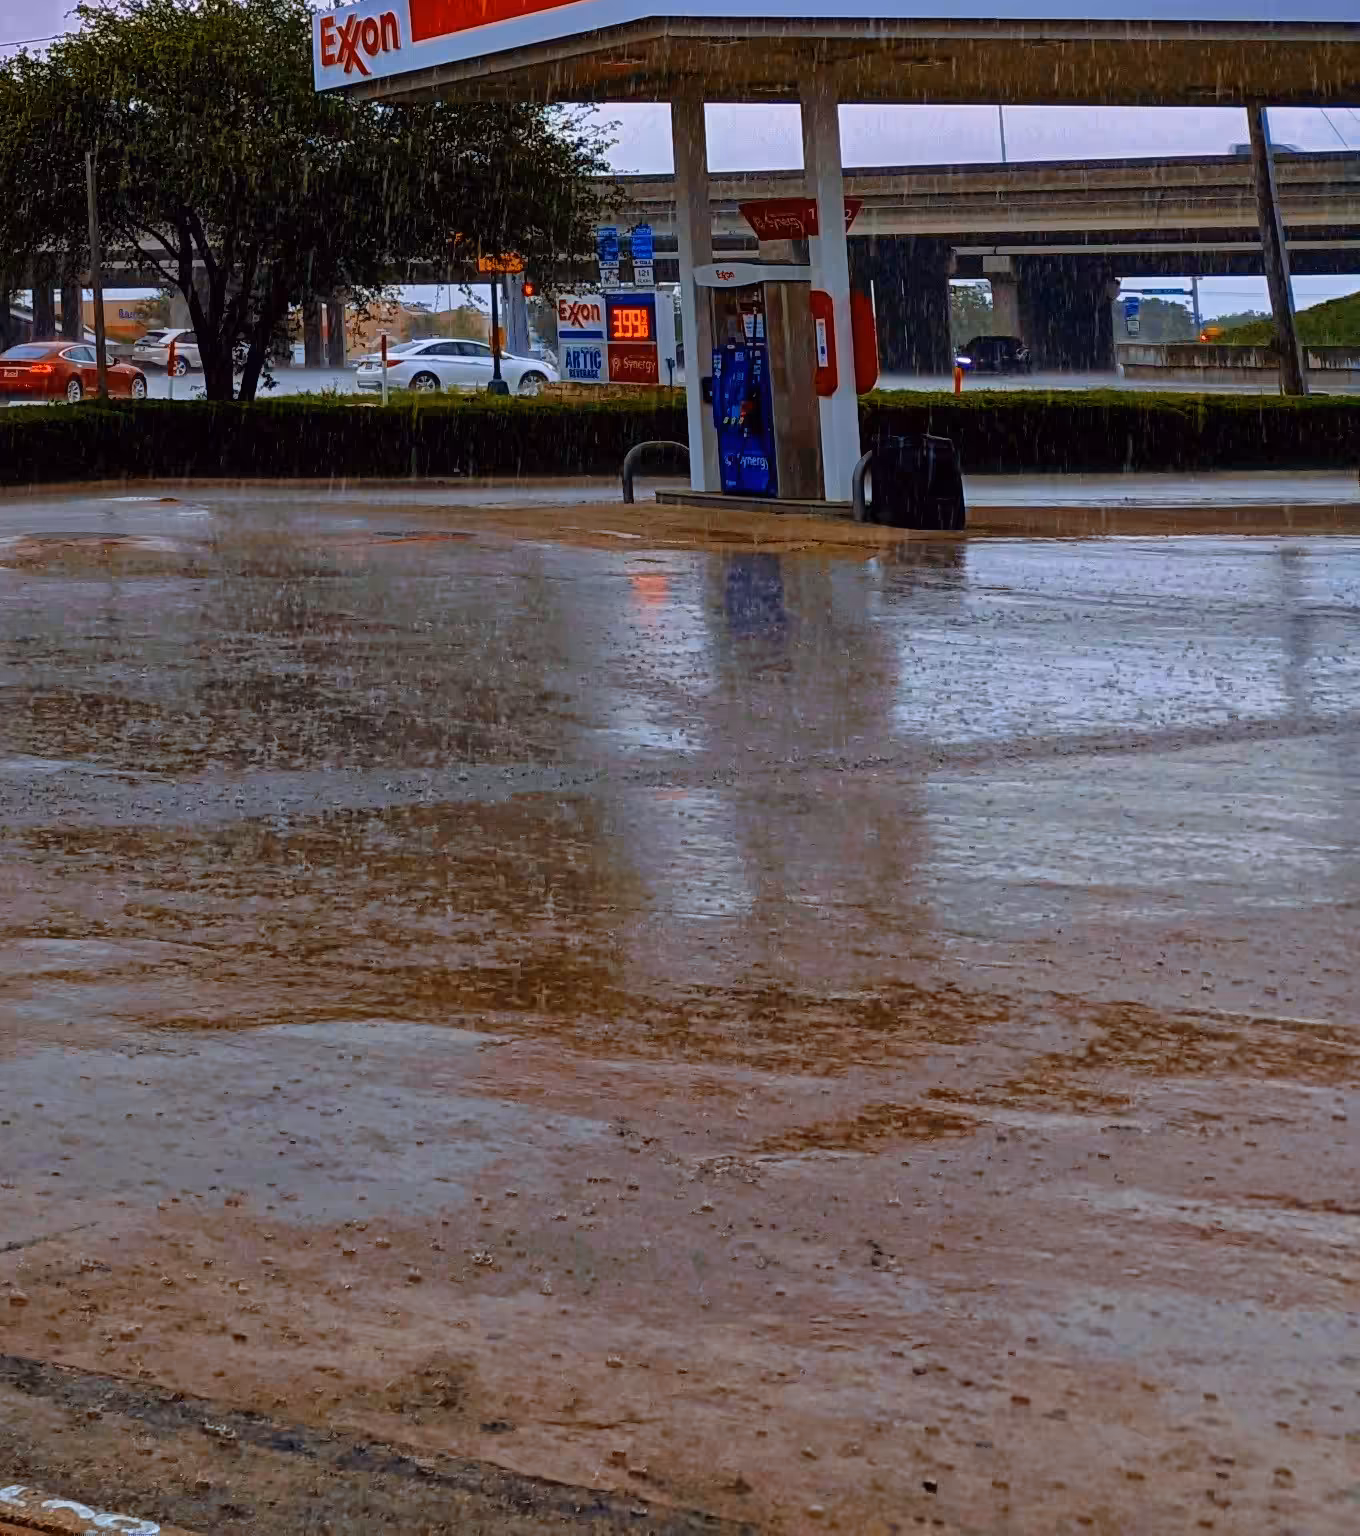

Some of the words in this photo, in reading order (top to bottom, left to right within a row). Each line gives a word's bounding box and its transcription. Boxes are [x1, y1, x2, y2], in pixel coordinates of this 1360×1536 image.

[320, 11, 401, 76] Exxon
[808, 207, 816, 220] 1
[844, 208, 853, 221] 2
[559, 300, 601, 328] Exxon
[565, 347, 602, 369] ARTIC
[623, 356, 656, 374] Synergy
[568, 368, 600, 379] BEVERAGE
